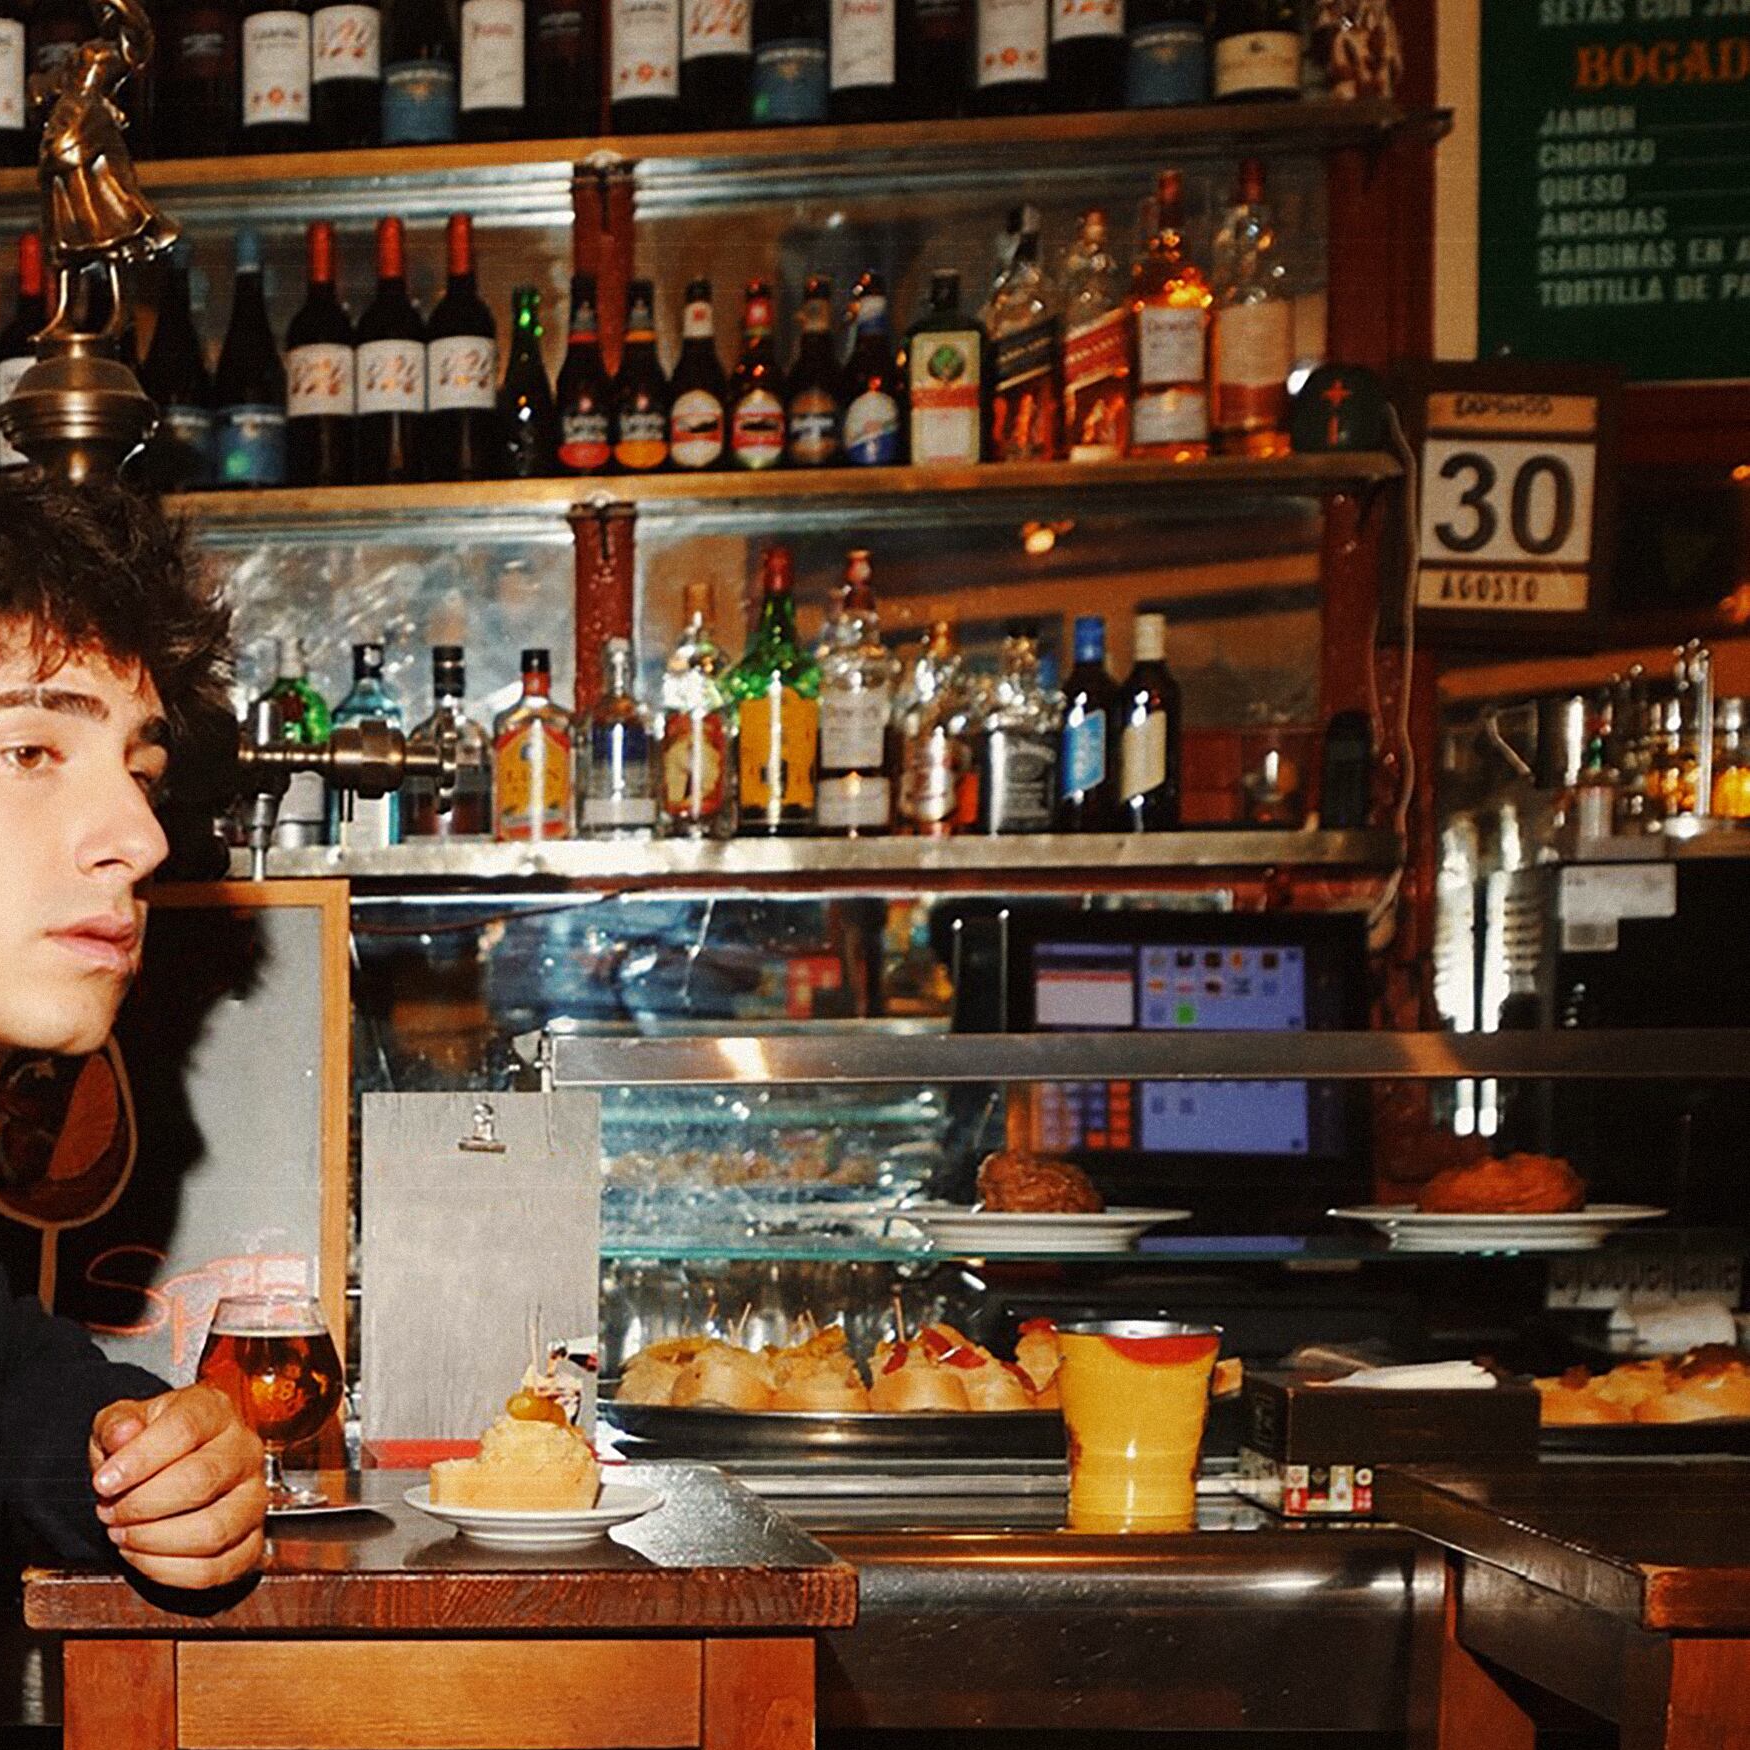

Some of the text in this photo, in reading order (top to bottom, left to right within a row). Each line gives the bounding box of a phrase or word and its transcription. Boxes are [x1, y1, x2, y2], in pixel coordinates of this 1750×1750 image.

[1539, 105, 1637, 136] JAMON
[1538, 138, 1657, 169] CHORIZO
[1538, 173, 1627, 206] QUESO
[1538, 207, 1668, 238] ANCHOAS
[1538, 239, 1677, 273] SARDINAS
[1688, 237, 1725, 264] EN
[1538, 275, 1664, 307] TORTILLA
[1675, 273, 1709, 301] DE
[1434, 451, 1575, 556] 30
[1440, 574, 1540, 603] AGOSTO
